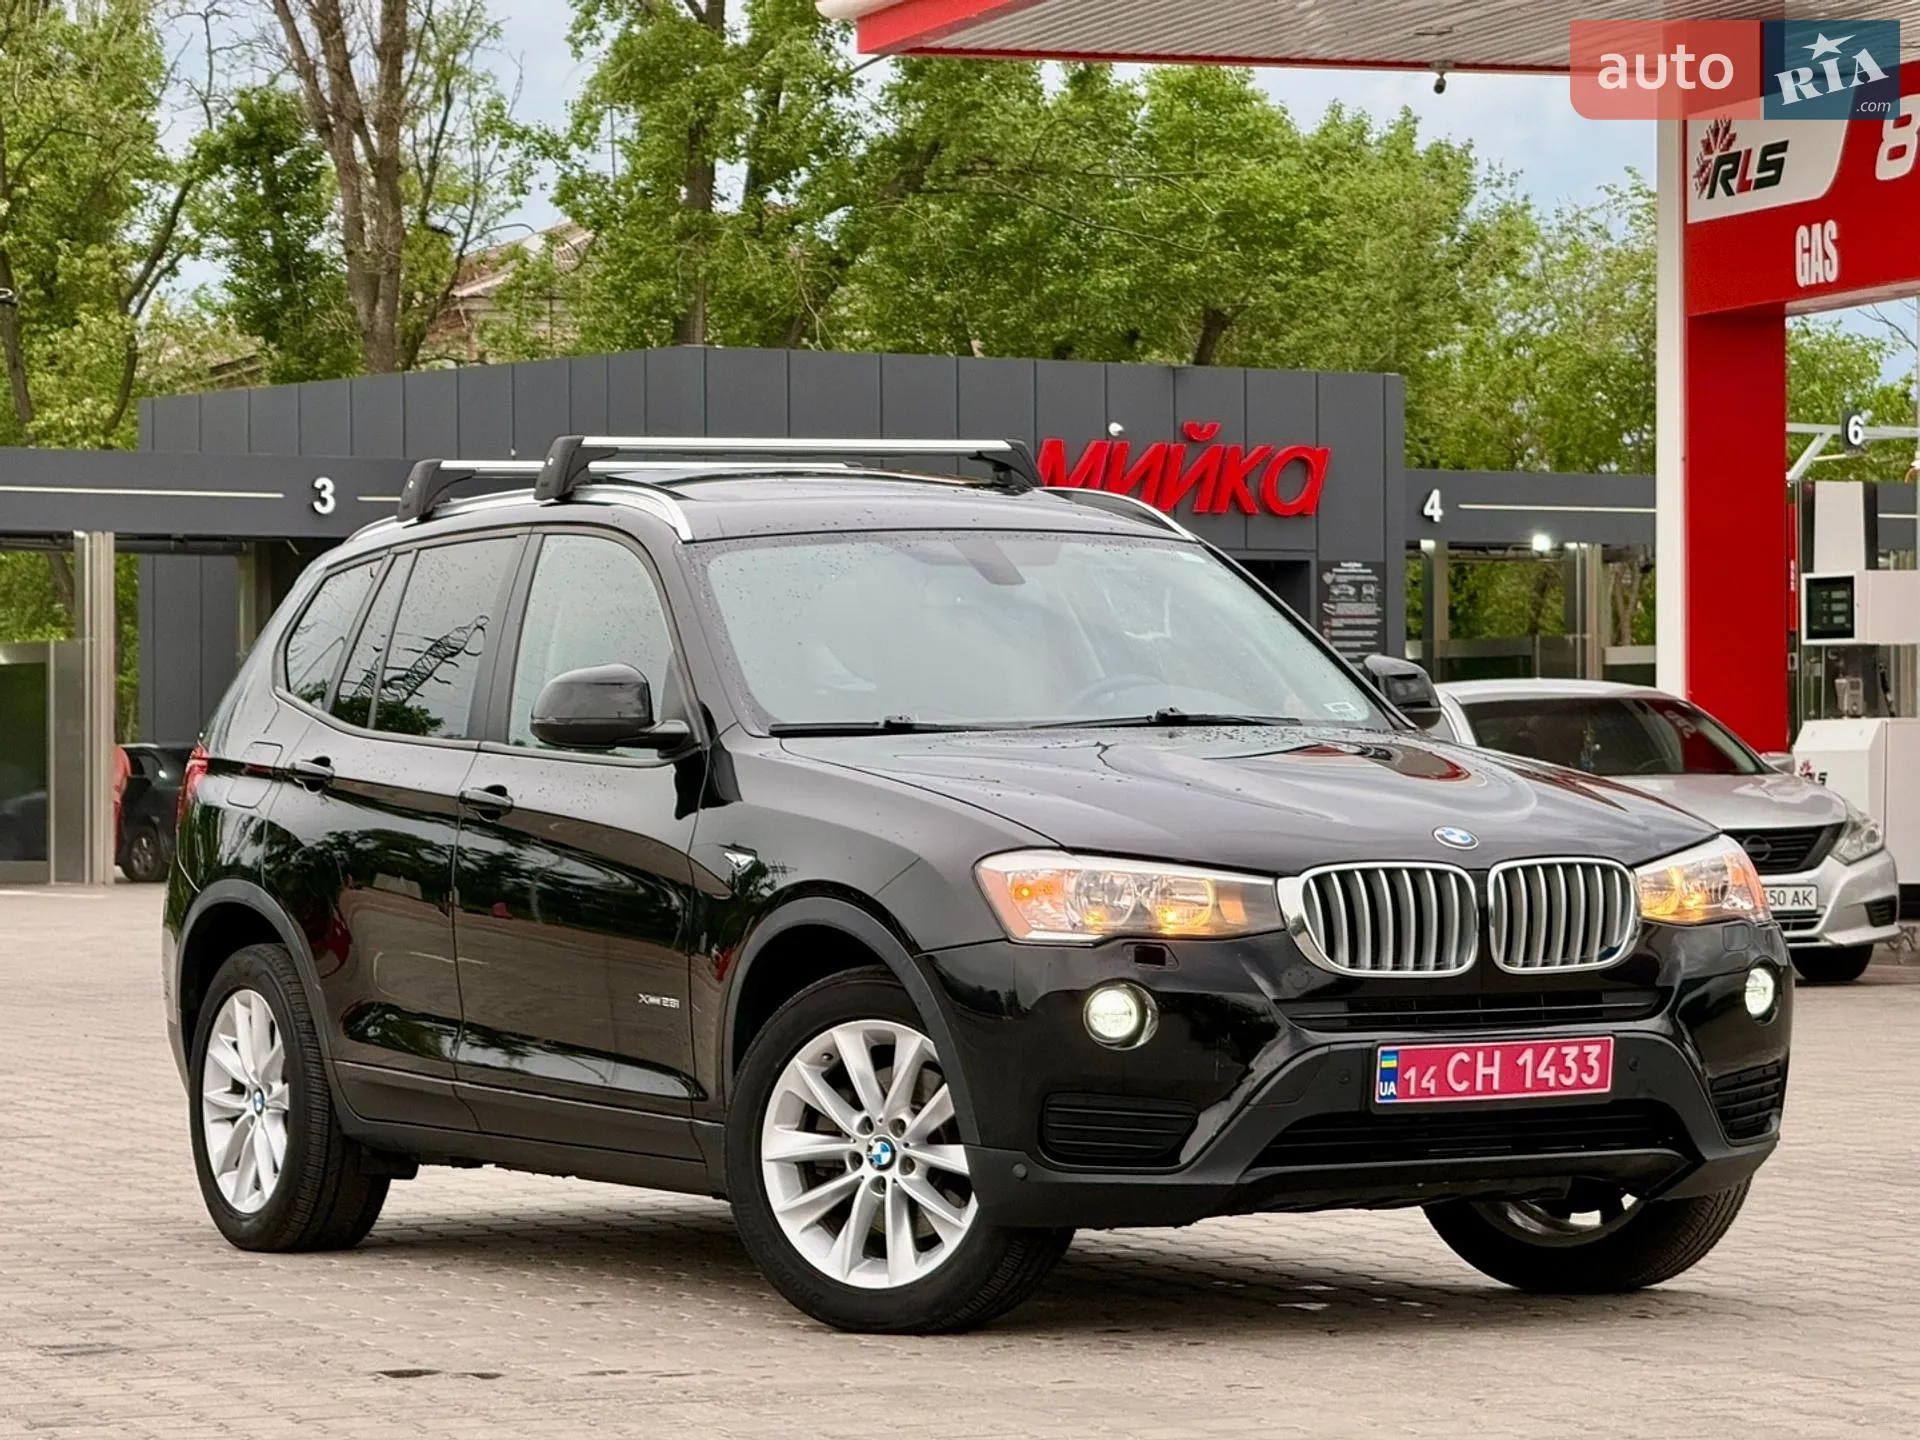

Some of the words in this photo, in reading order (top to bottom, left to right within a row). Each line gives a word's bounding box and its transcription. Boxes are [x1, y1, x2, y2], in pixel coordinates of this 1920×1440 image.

[1706, 140, 1790, 200] RLS
[1794, 219, 1839, 288] GAS
[1848, 415, 1865, 446] 6
[313, 476, 336, 515] 3
[1422, 488, 1444, 523] 4
[1790, 890, 1813, 906] AK
[1403, 1065, 1438, 1096] 14
[1446, 1050, 1501, 1092] CH
[1516, 1044, 1602, 1089] 1433
[1379, 1081, 1398, 1097] UA
